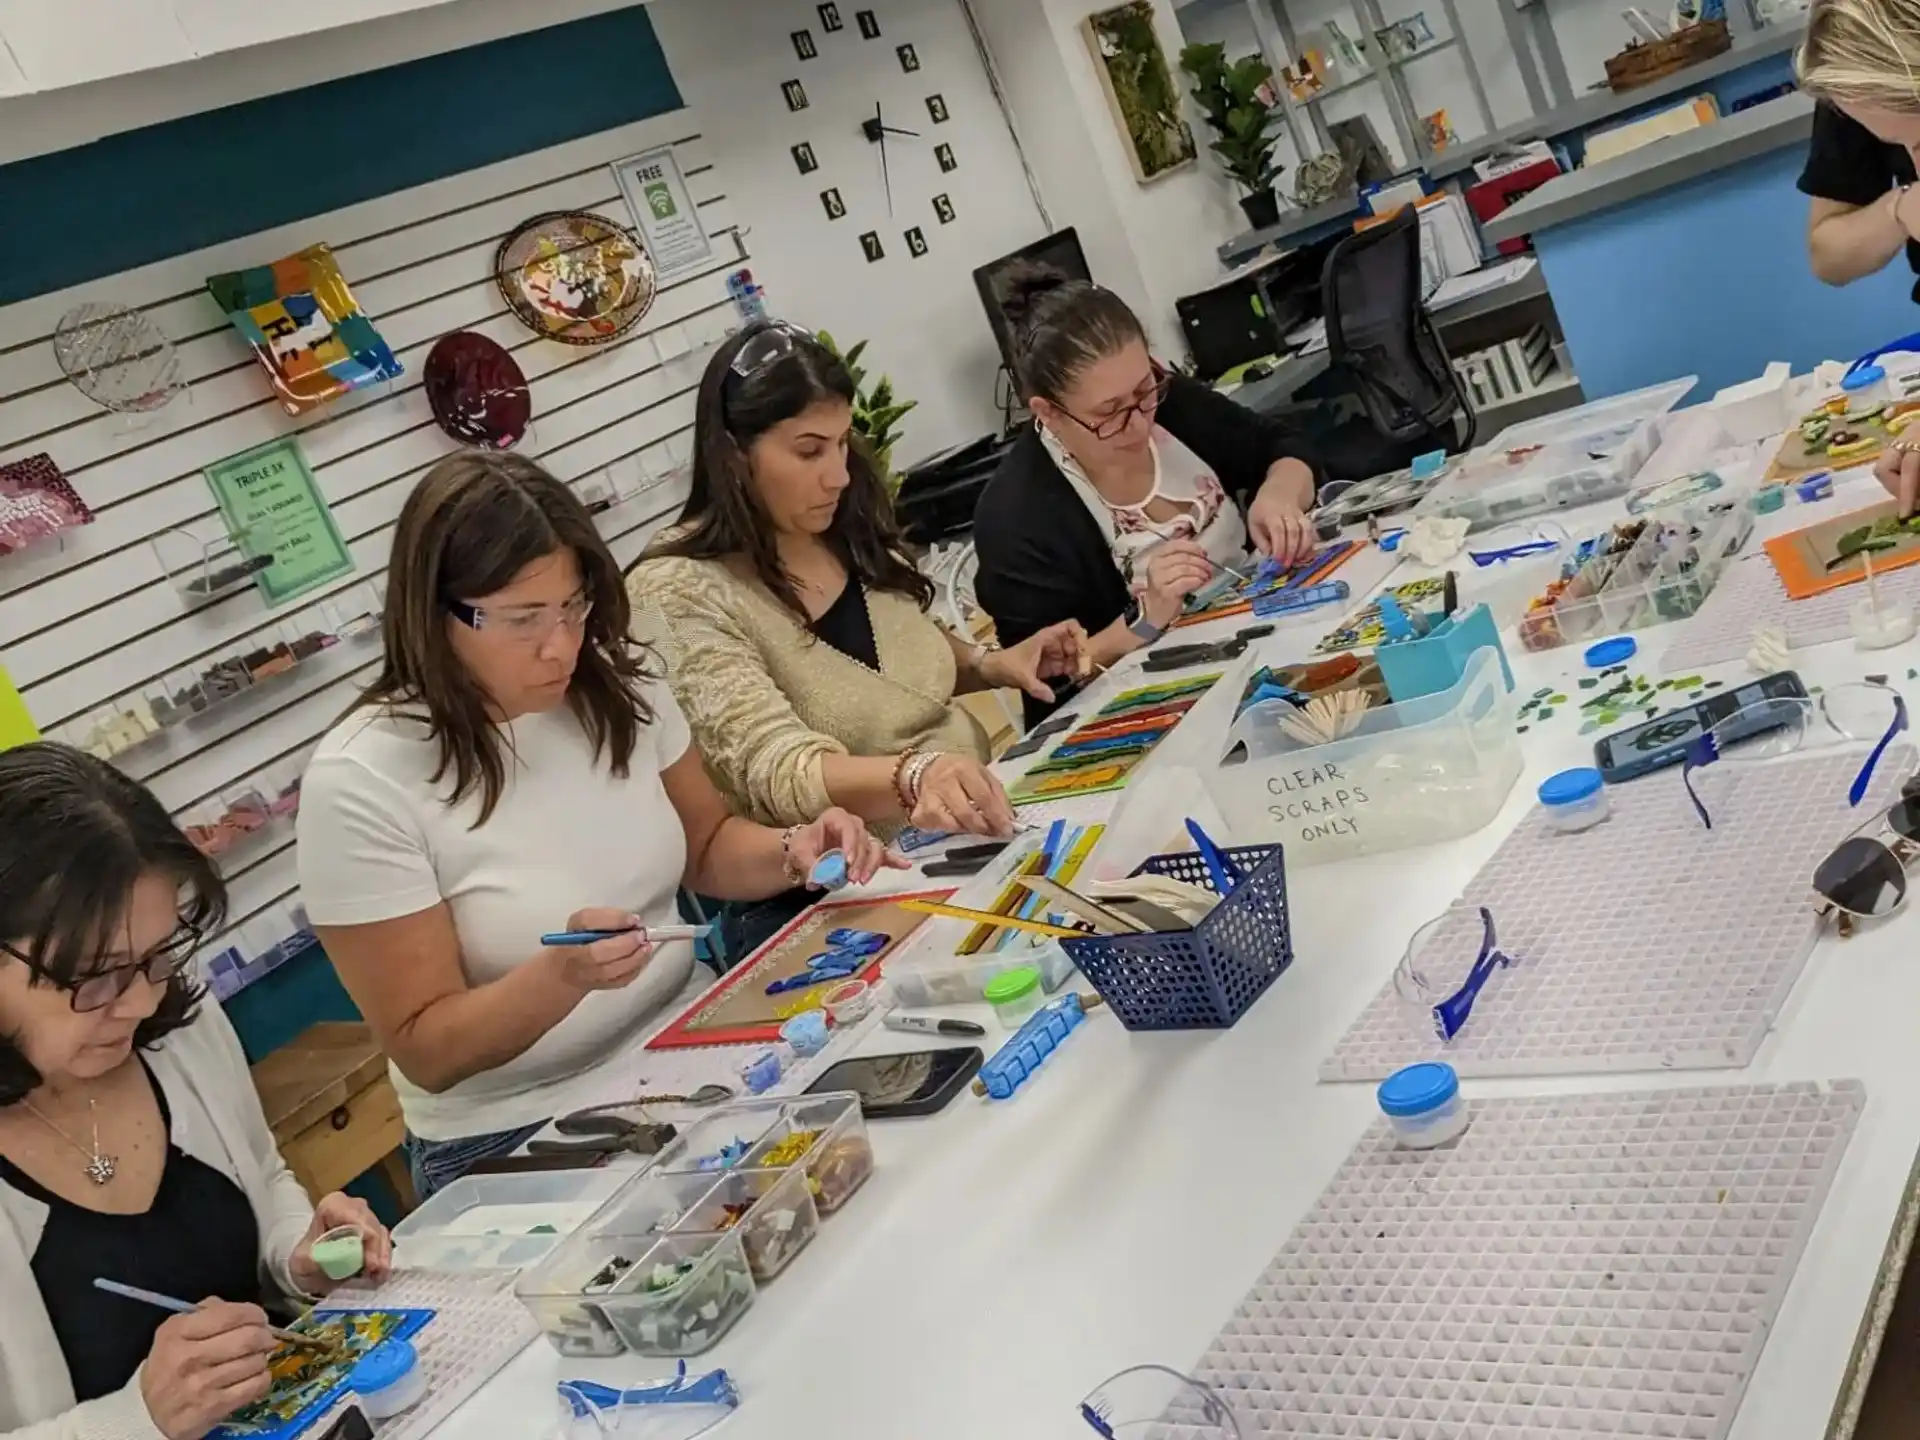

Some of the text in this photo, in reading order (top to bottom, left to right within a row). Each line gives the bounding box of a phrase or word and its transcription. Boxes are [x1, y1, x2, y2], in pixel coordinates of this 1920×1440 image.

[787, 83, 808, 109] 10
[636, 164, 663, 184] FREE
[937, 194, 954, 221] 5
[236, 466, 272, 489] TRIPLE
[1267, 763, 1345, 795] CLEAR
[1268, 786, 1370, 823] SCRAPS
[1302, 816, 1359, 841] ONLY
